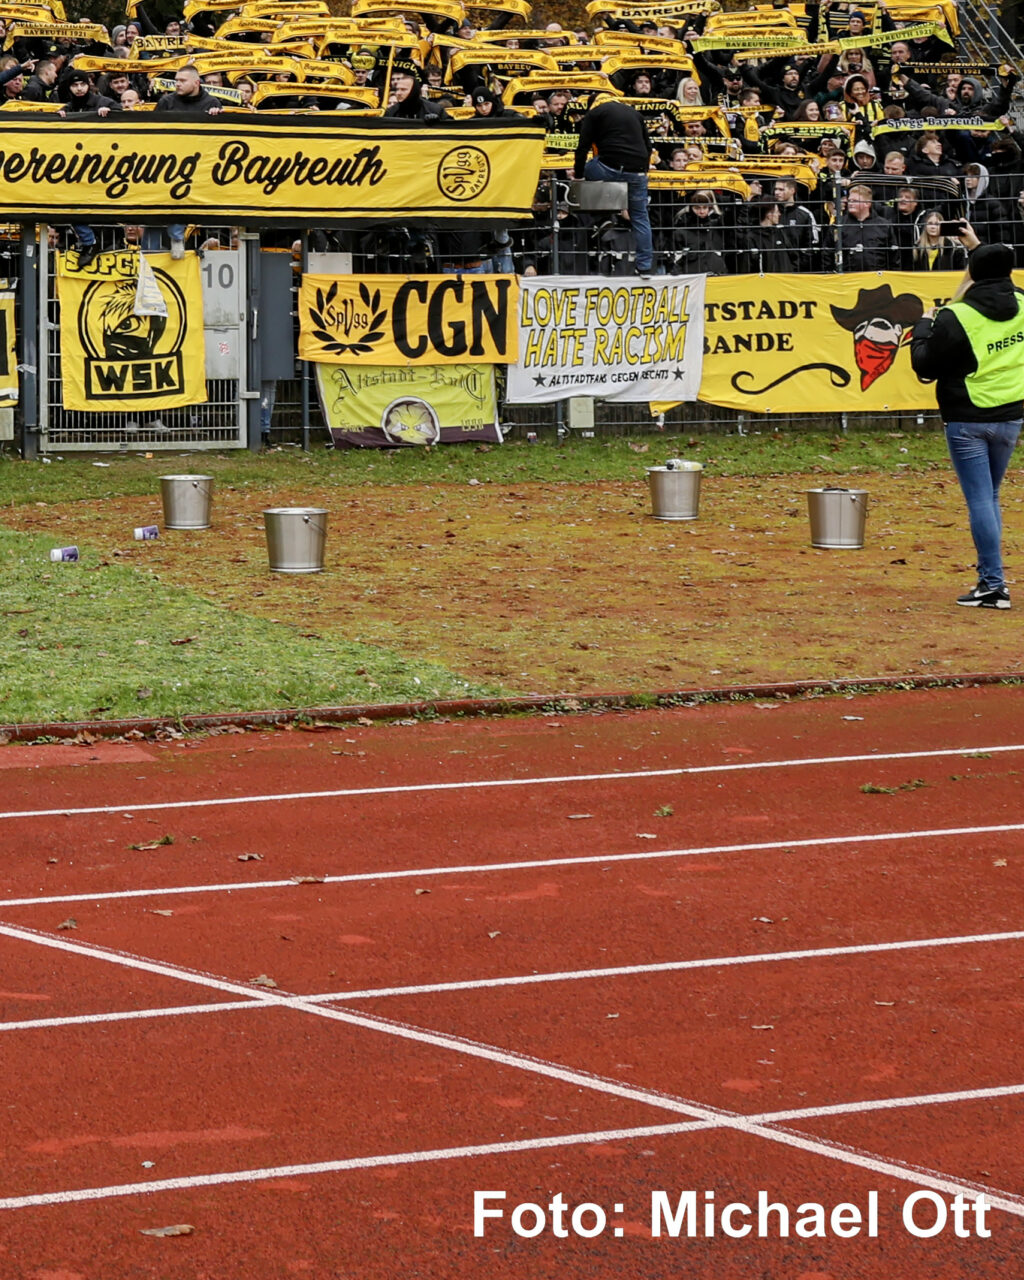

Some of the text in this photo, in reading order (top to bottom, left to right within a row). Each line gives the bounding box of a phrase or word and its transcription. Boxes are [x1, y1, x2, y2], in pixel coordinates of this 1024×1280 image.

[622, 1, 706, 17] BAYREUTH
[869, 28, 933, 45] BAYREUTH 1921
[887, 116, 985, 130] SpVgg Bayreuth
[212, 140, 388, 195] Bayreuth
[443, 151, 476, 196] SpVgg
[470, 154, 486, 193] BAYREUTH
[203, 263, 234, 288] 10
[326, 279, 511, 358] SpVgg CGN
[521, 285, 690, 328] LOVE FOOTBALL
[704, 299, 818, 322] TSTADT
[524, 323, 688, 369] HATE RACISM
[986, 331, 1024, 355] PRESS
[94, 360, 176, 391] WSK
[548, 368, 670, 388] ALTSTADTFANS GEGEN RECHTS
